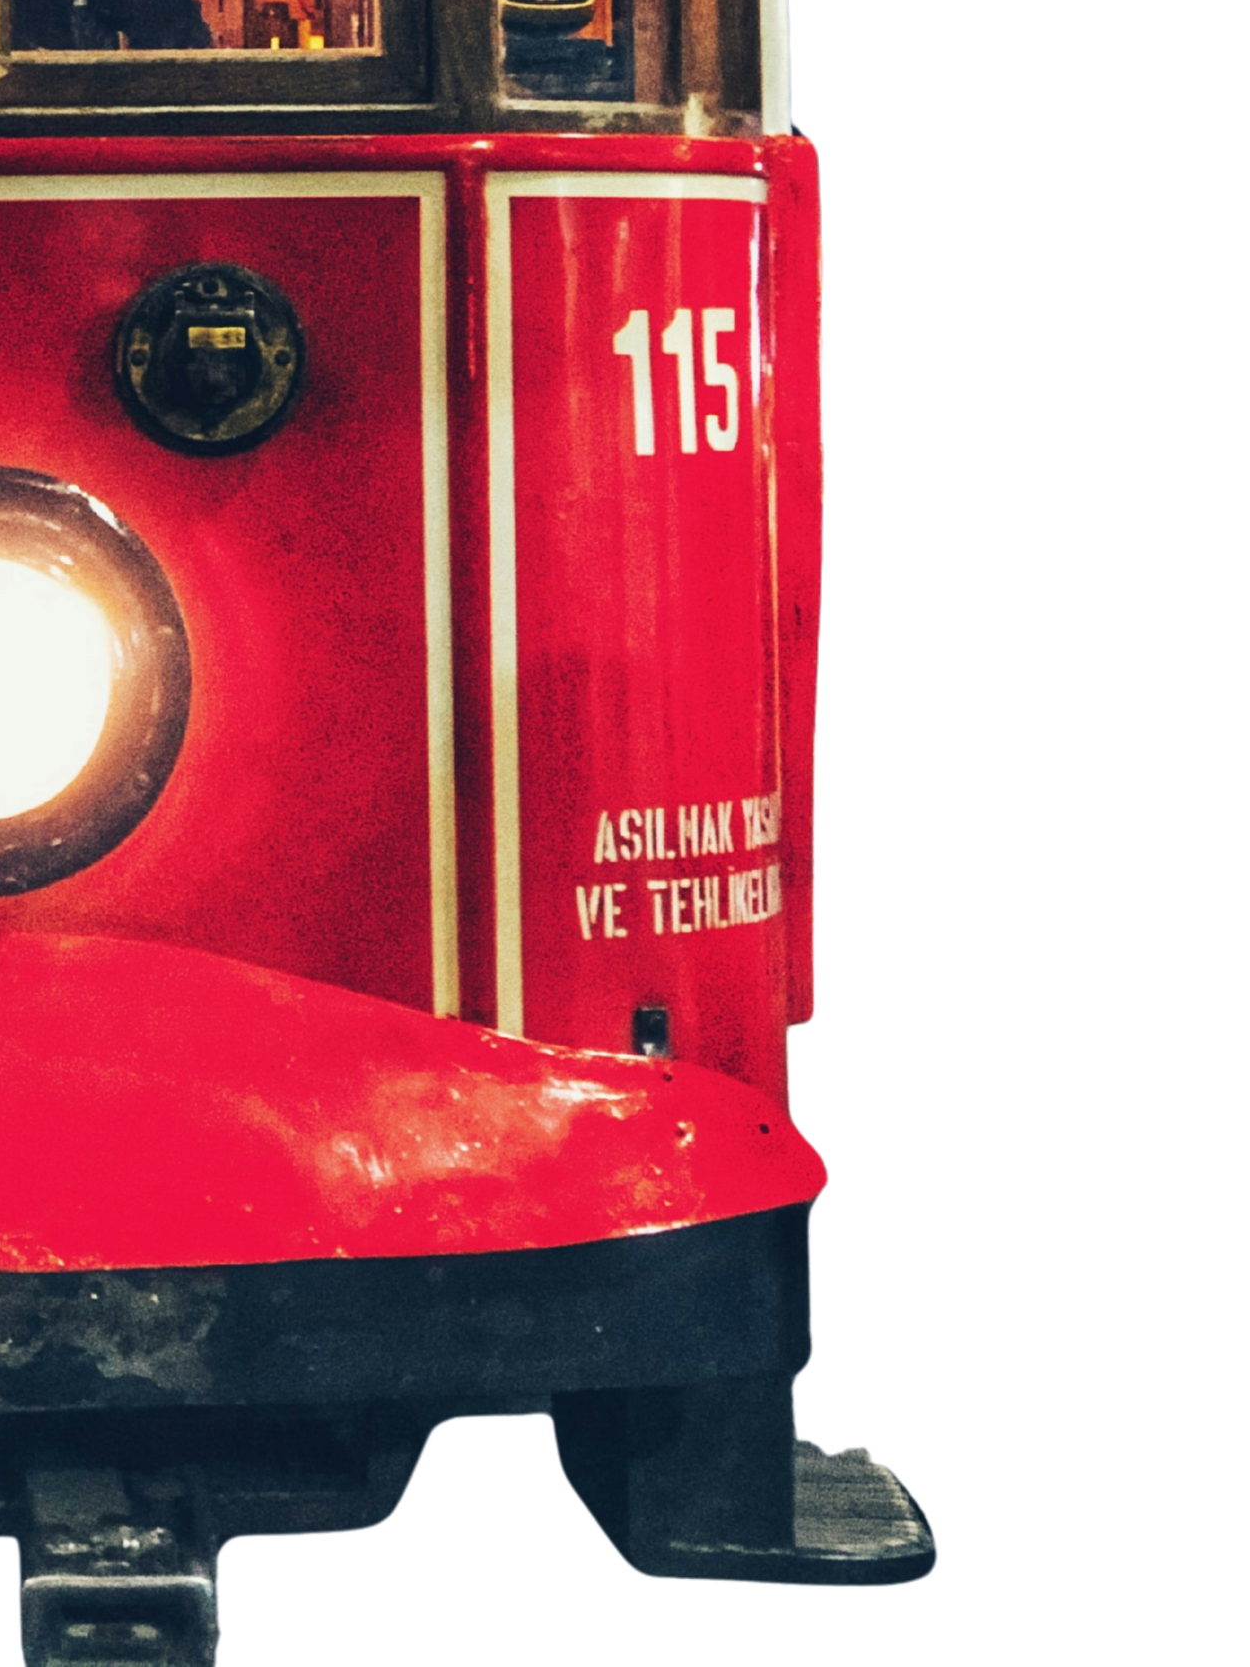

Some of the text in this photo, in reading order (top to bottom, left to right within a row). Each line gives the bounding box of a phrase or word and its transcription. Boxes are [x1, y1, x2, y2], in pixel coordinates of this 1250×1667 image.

[612, 307, 740, 457] 115
[594, 800, 734, 864] ASILMAK
[576, 884, 628, 940] VE
